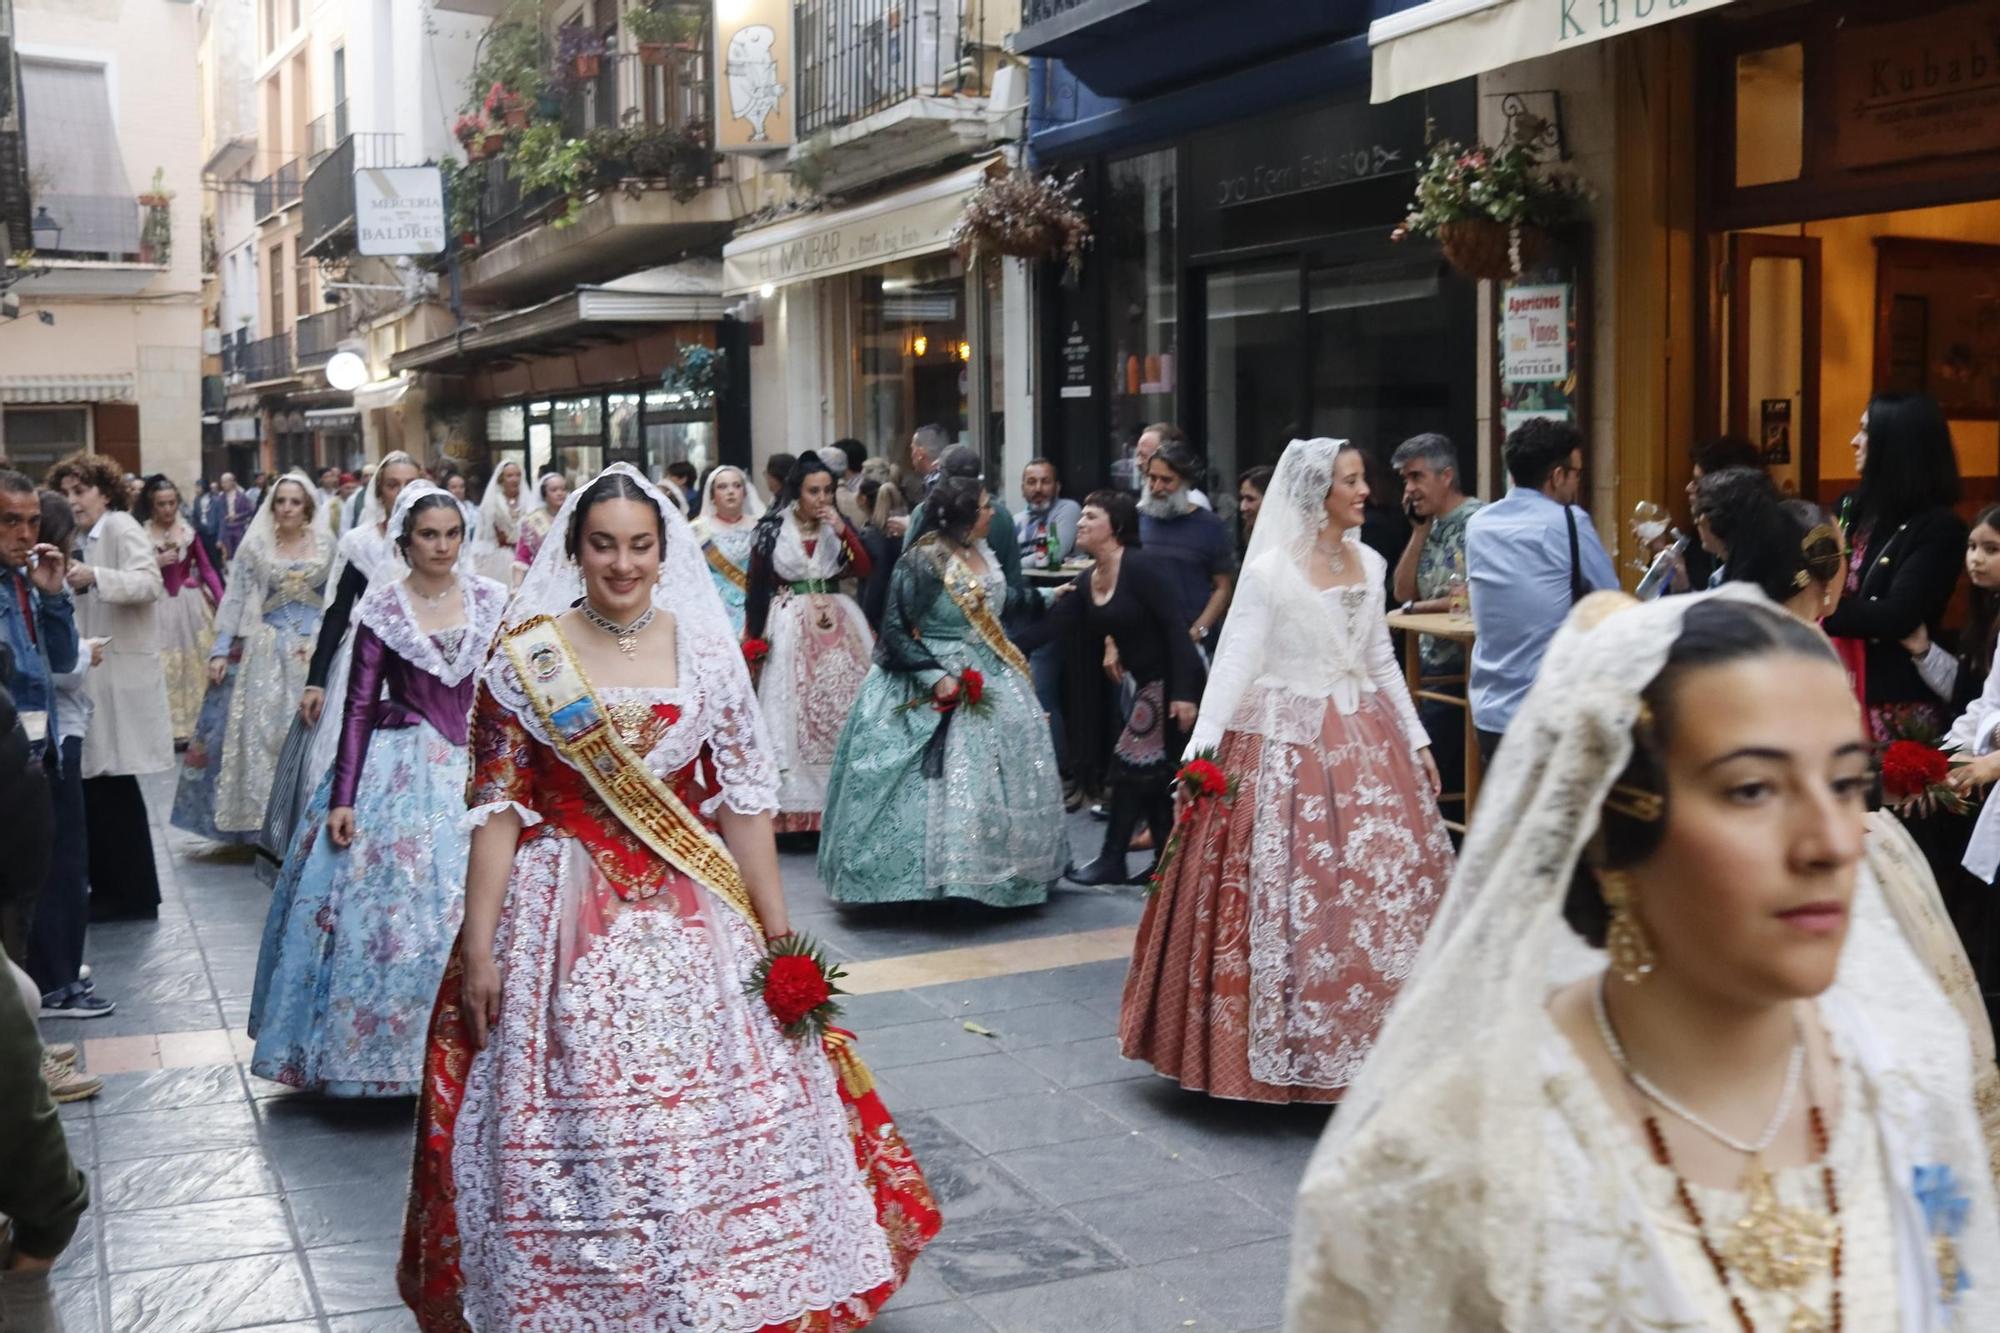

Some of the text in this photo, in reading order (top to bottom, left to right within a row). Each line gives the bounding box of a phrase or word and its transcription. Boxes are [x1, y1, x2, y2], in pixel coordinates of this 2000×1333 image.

[1868, 39, 2000, 98] Kubab
[362, 226, 443, 241] BALDRES
[781, 232, 841, 273] MINIBAR
[1509, 295, 1560, 314] Aperitivos
